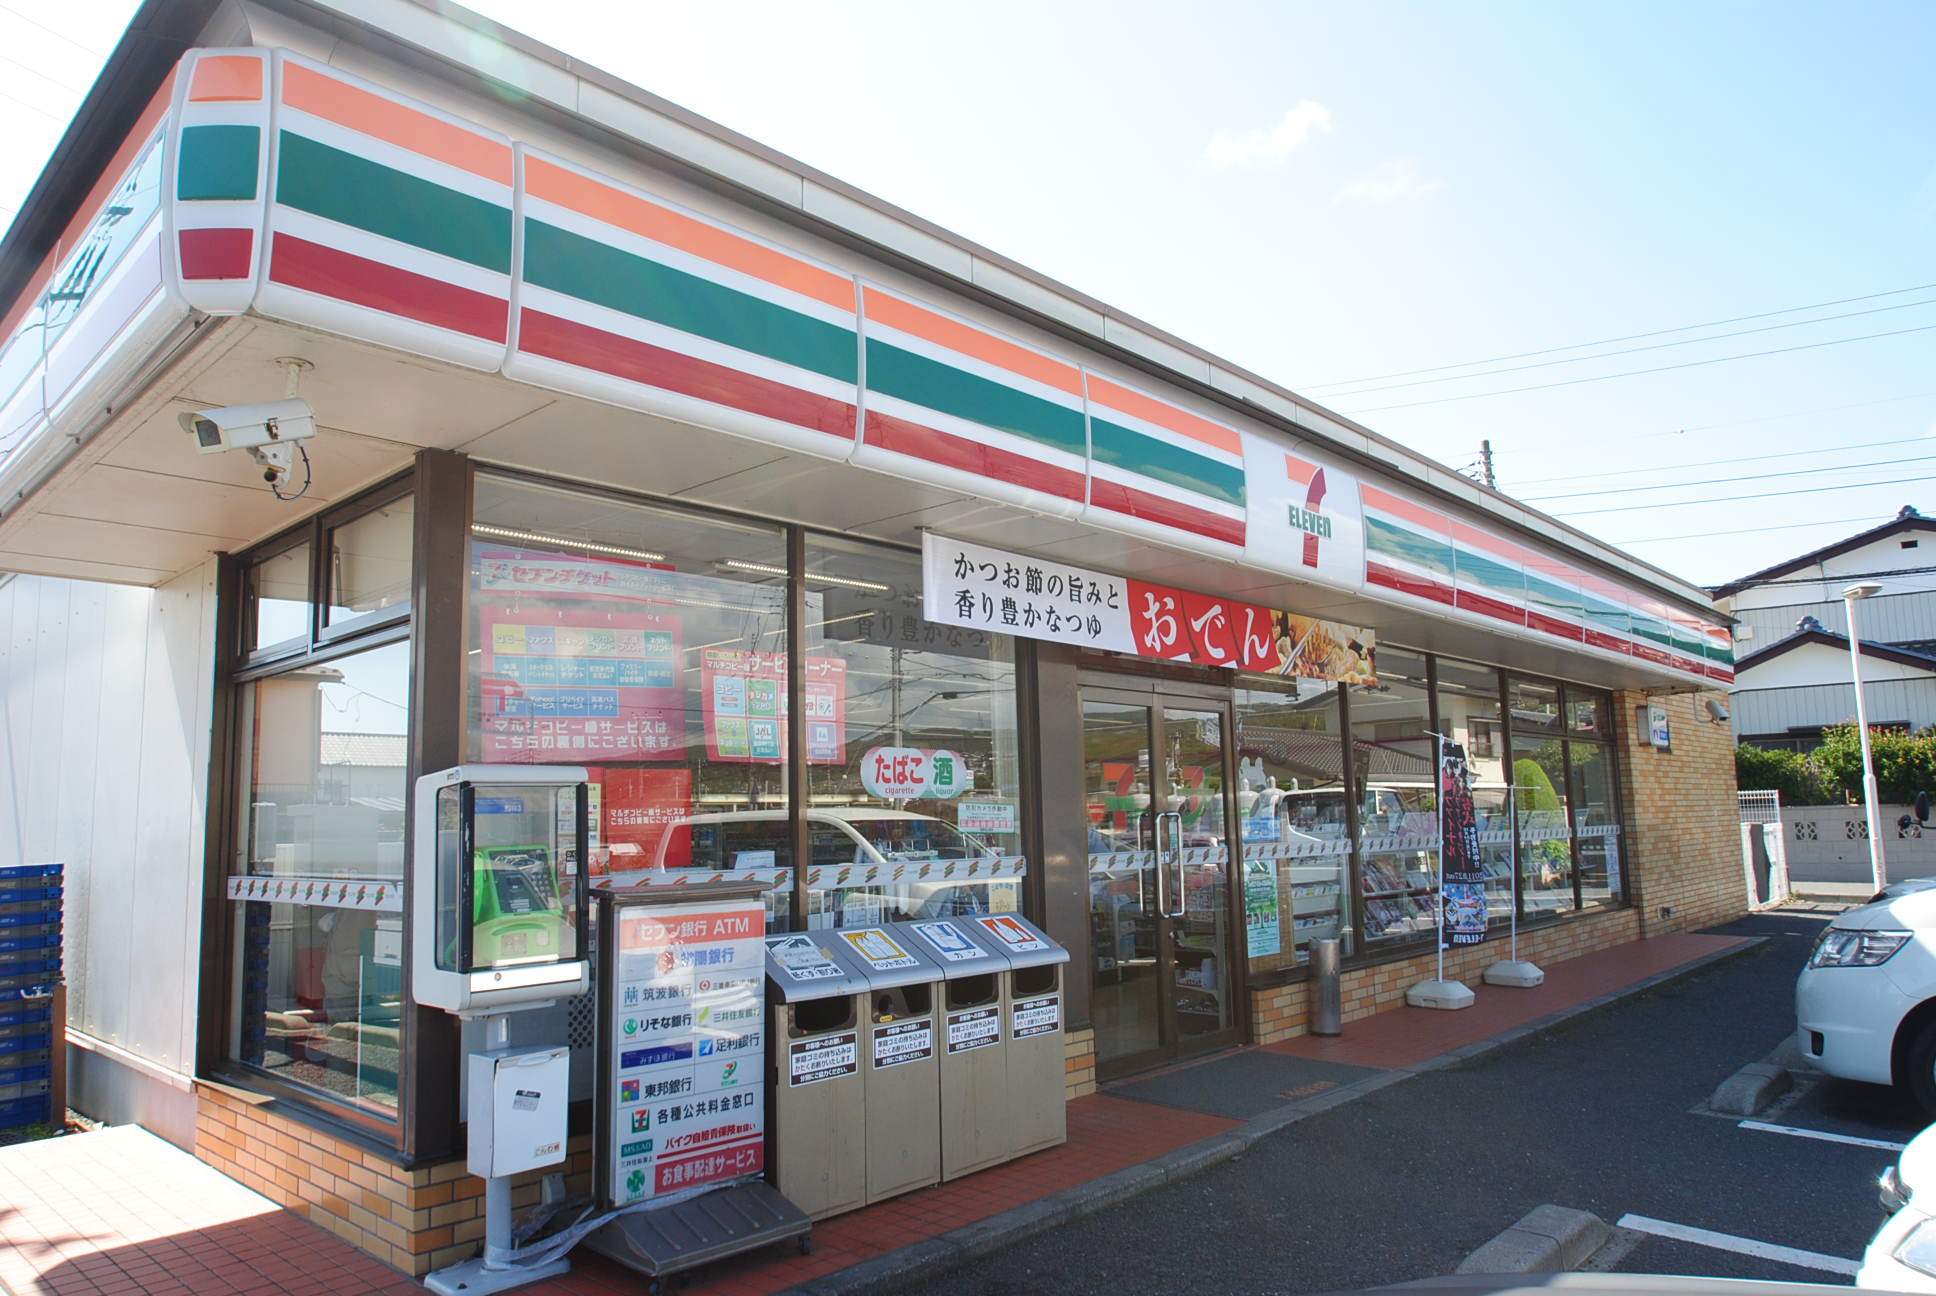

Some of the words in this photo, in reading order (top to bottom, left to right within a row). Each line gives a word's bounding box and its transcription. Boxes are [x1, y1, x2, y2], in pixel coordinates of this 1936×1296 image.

[512, 566, 617, 586] セブンチケット
[954, 552, 1119, 609] かつお節の旨みと
[954, 589, 1102, 640] 香り豊かなつゆ
[1142, 592, 1270, 666] おでん
[875, 754, 924, 785] たばこ
[933, 757, 953, 785] 酒
[884, 787, 915, 796] cigarette
[713, 917, 749, 935] ATM
[642, 984, 692, 1001] 筑波銀行
[640, 1013, 692, 1032] りそな銀行
[716, 1032, 760, 1052] 足利銀行
[644, 1077, 692, 1099] 東邦銀行
[657, 1093, 754, 1125] 各種公共料金窓口
[662, 1150, 756, 1186] お食事配達サービス
